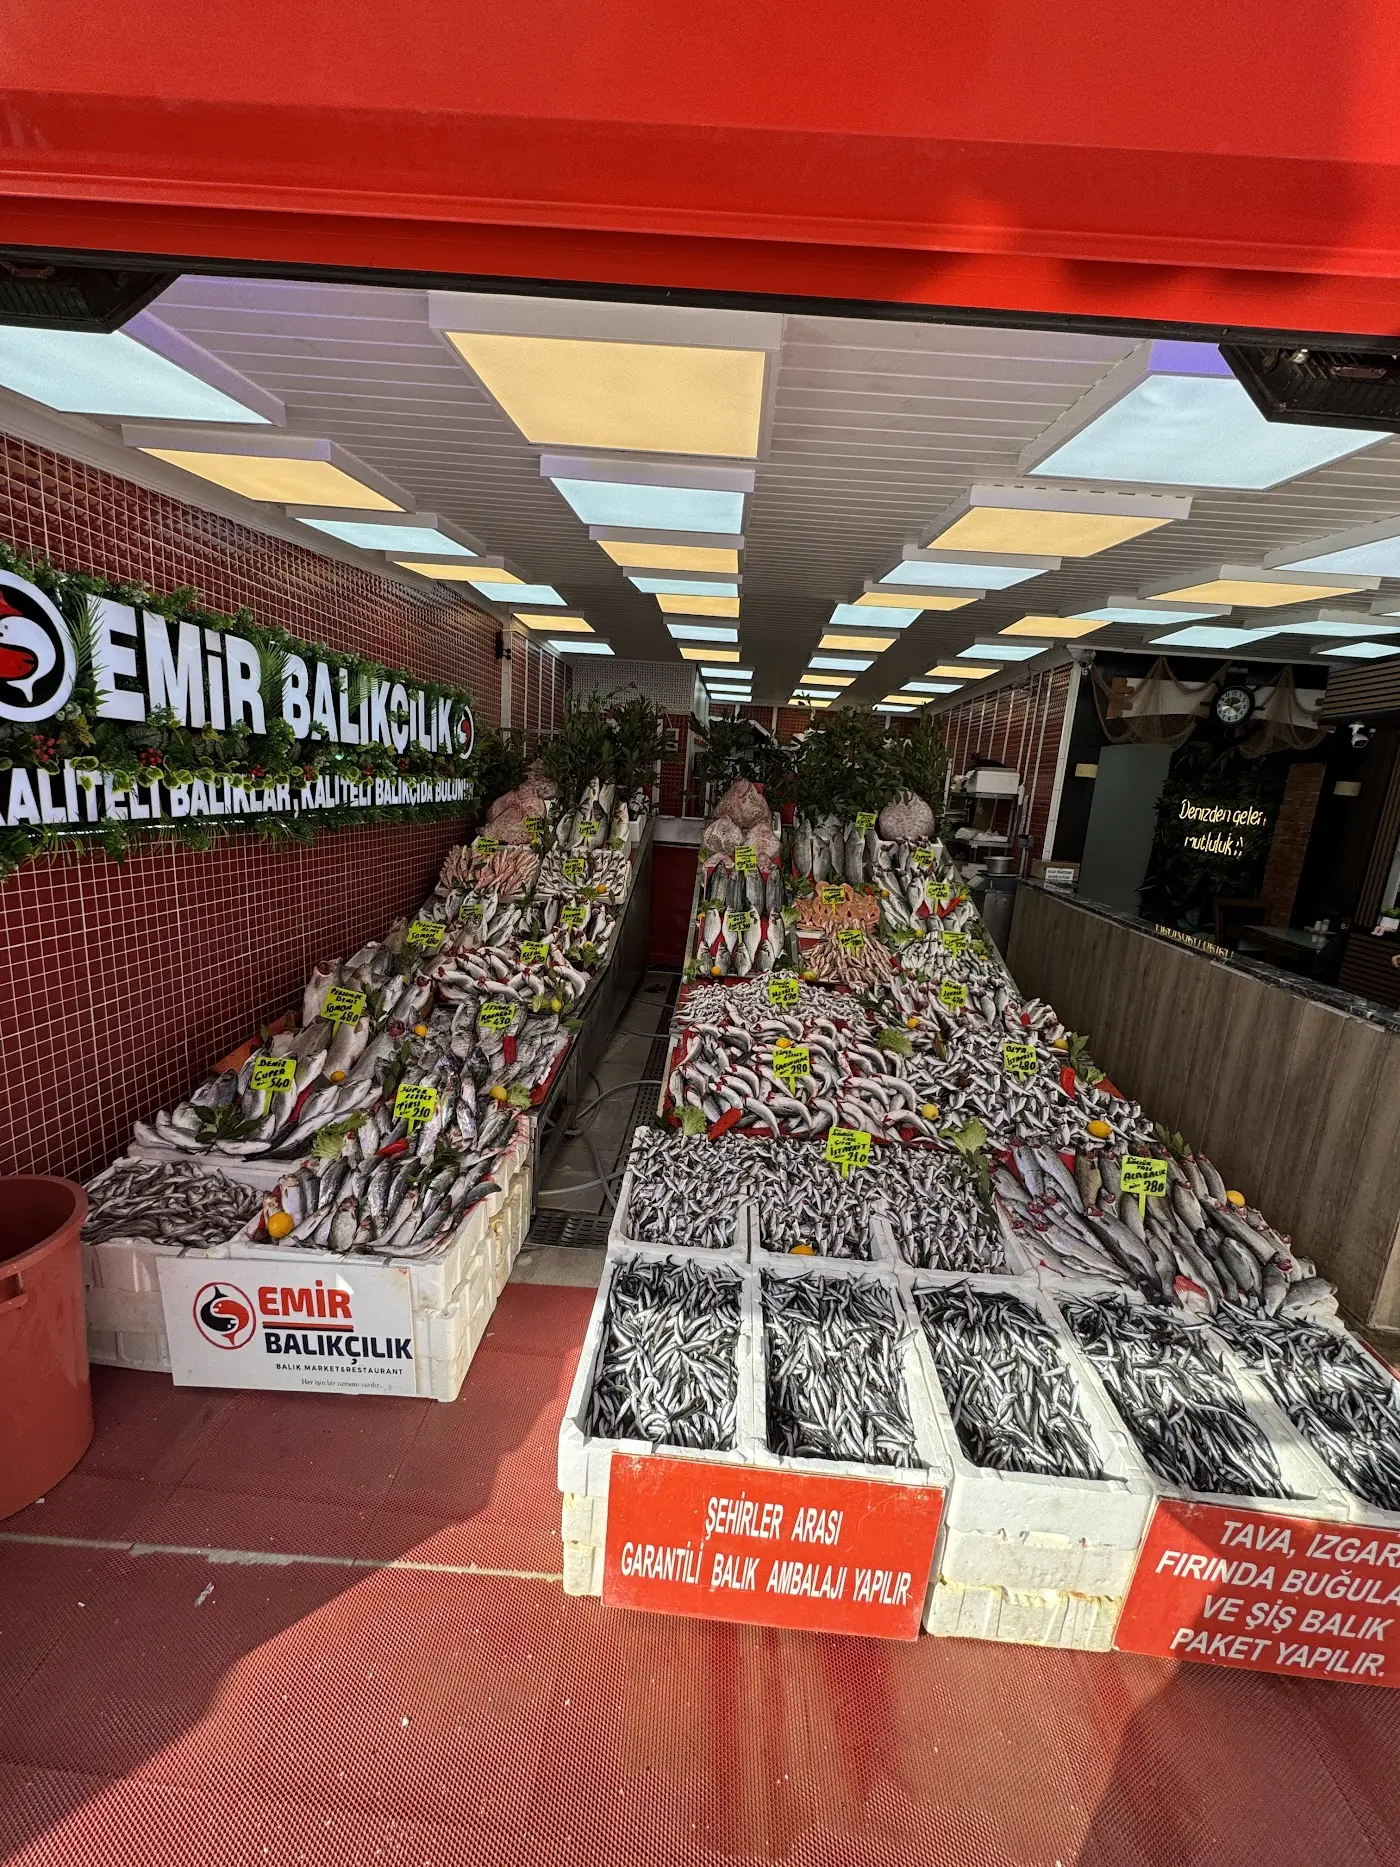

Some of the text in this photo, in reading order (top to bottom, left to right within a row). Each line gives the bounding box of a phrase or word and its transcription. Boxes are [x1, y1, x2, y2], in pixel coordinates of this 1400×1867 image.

[281, 653, 453, 754] BALIKÇILIK
[0, 757, 161, 826] ALİTELİ
[325, 1003, 353, 1013] SOMON
[340, 1011, 359, 1022] 480
[493, 1017, 511, 1025] 430
[269, 1078, 290, 1088] 540
[846, 1152, 867, 1163] 210
[1123, 1169, 1167, 1181] ALABALIK
[1143, 1180, 1164, 1192] 380
[258, 1280, 352, 1319] EMİR
[265, 1332, 413, 1365] BALIKÇILIK
[276, 1363, 403, 1375] BALIK MARKET&RESTAURANT
[705, 1492, 844, 1546] ŞEHİRLER ARASI
[1219, 1520, 1400, 1569] TAVA, IZGAR
[621, 1540, 912, 1606] GARANTİLİ BALIK AMBALAJI YAPILIR
[1154, 1550, 1276, 1590] FIRINDA
[1203, 1595, 1395, 1642] VE ŞİŞ BALIK
[1169, 1628, 1386, 1677] PAKET YAPILIR.
